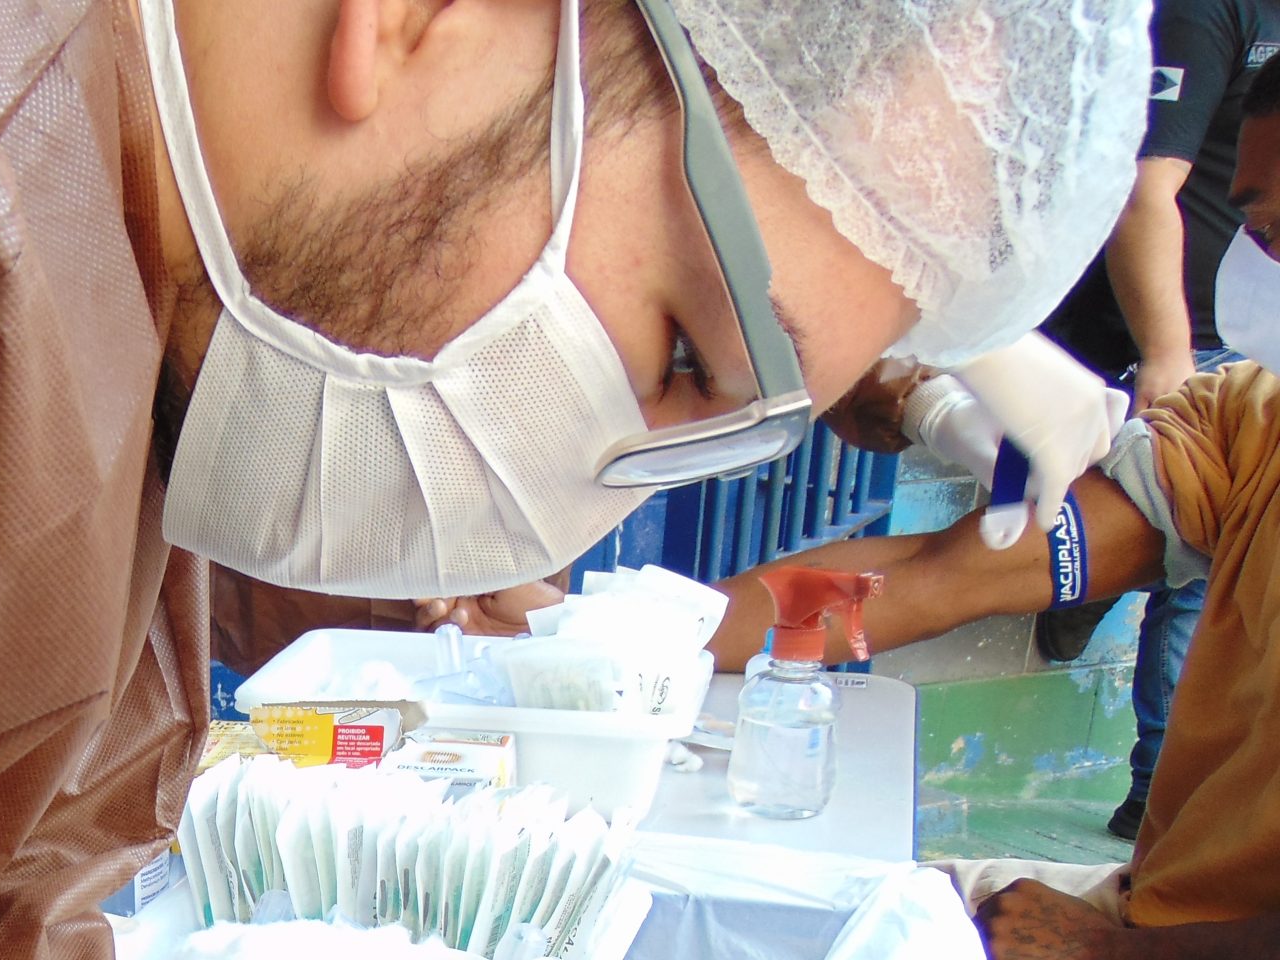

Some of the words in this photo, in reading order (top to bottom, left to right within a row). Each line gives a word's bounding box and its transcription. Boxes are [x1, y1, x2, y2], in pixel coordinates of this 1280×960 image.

[1246, 45, 1279, 63] AGE
[1054, 504, 1073, 602] VACUPLAS
[397, 764, 475, 774] DESCARPACK
